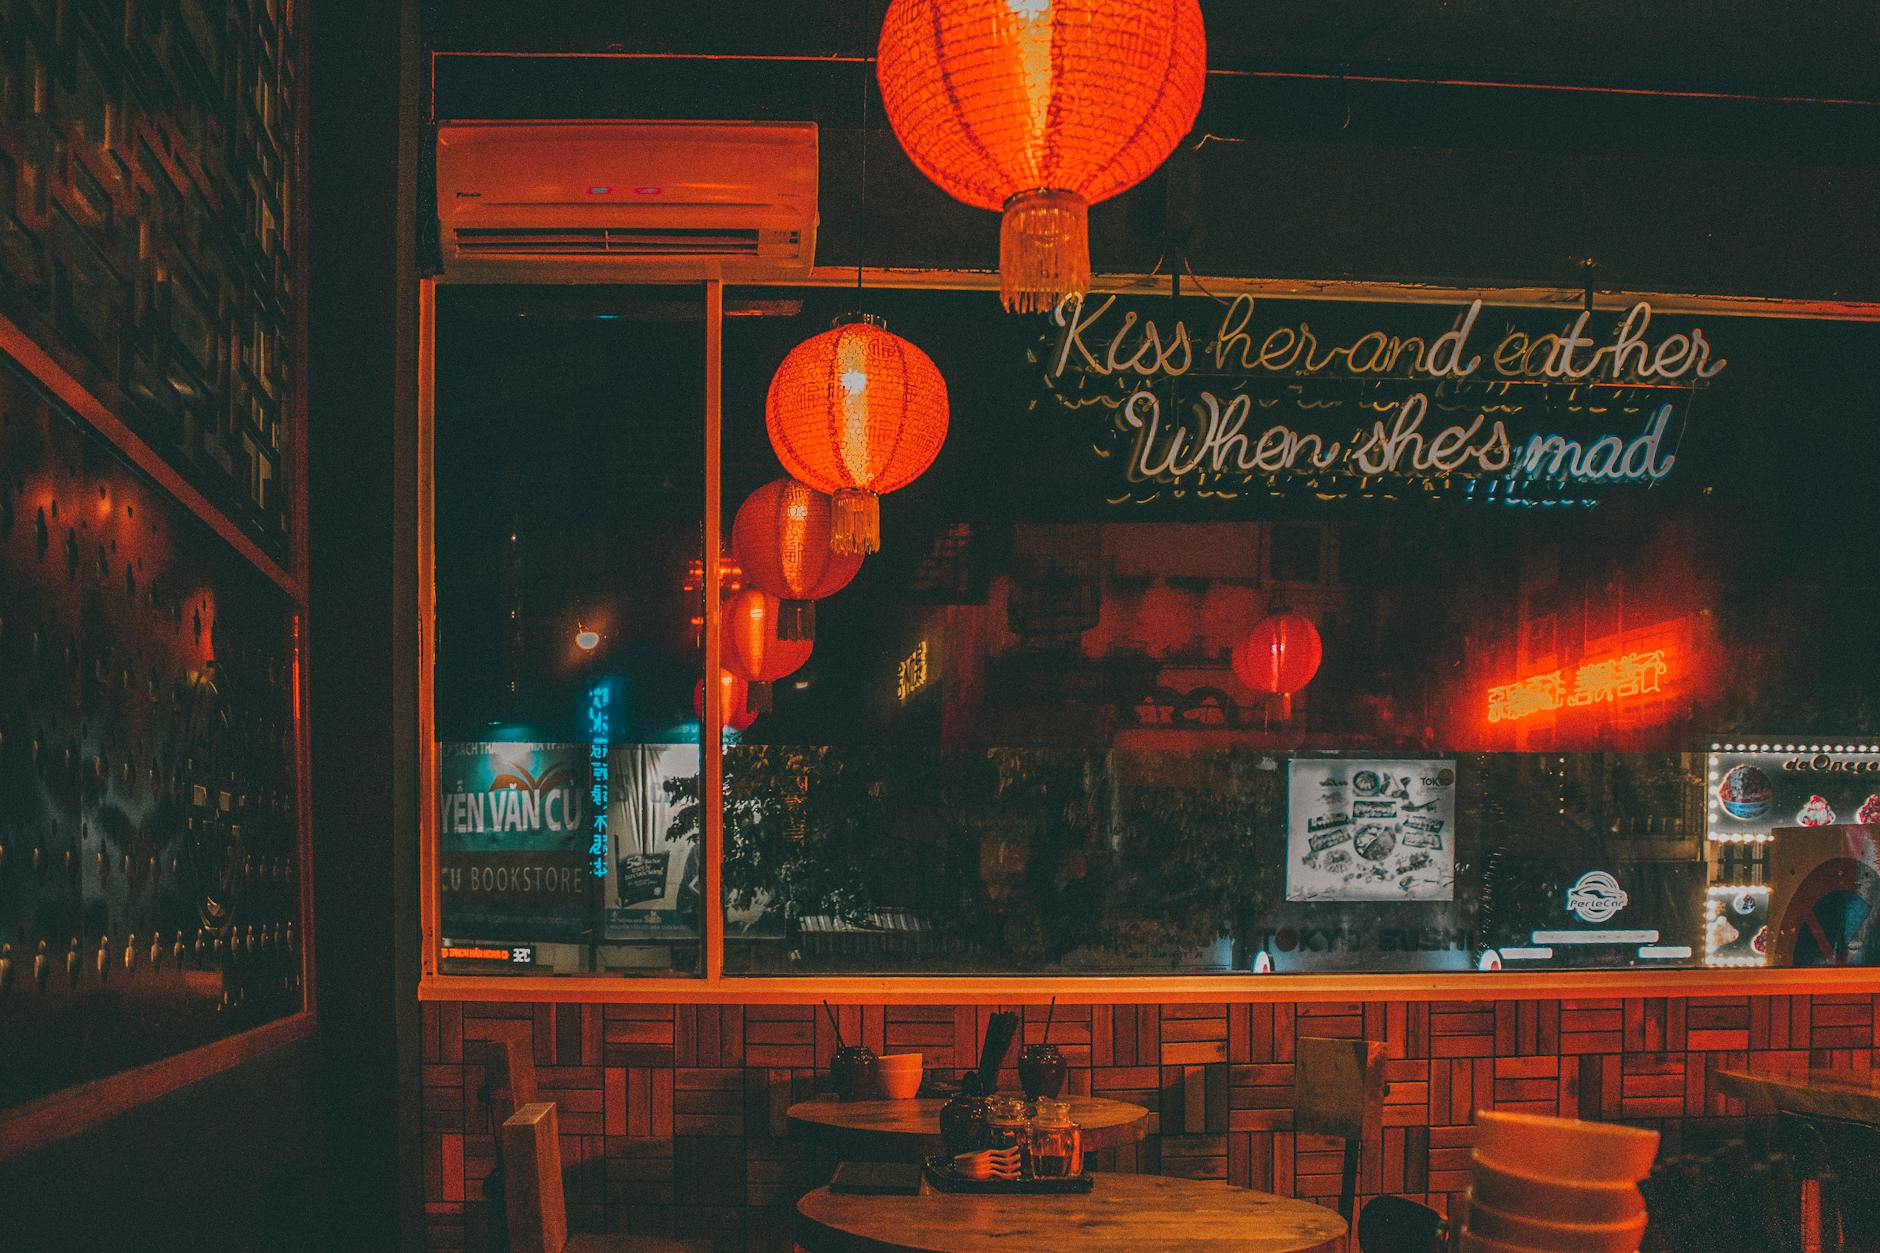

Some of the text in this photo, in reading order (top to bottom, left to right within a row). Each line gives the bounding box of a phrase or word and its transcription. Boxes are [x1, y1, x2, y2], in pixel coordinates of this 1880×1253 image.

[1055, 292, 1728, 378] Kiss her and eat her
[1124, 391, 1341, 476] When
[1522, 404, 1676, 478] mad
[488, 782, 540, 832] VĂN
[470, 866, 583, 893] BOOKSTORE
